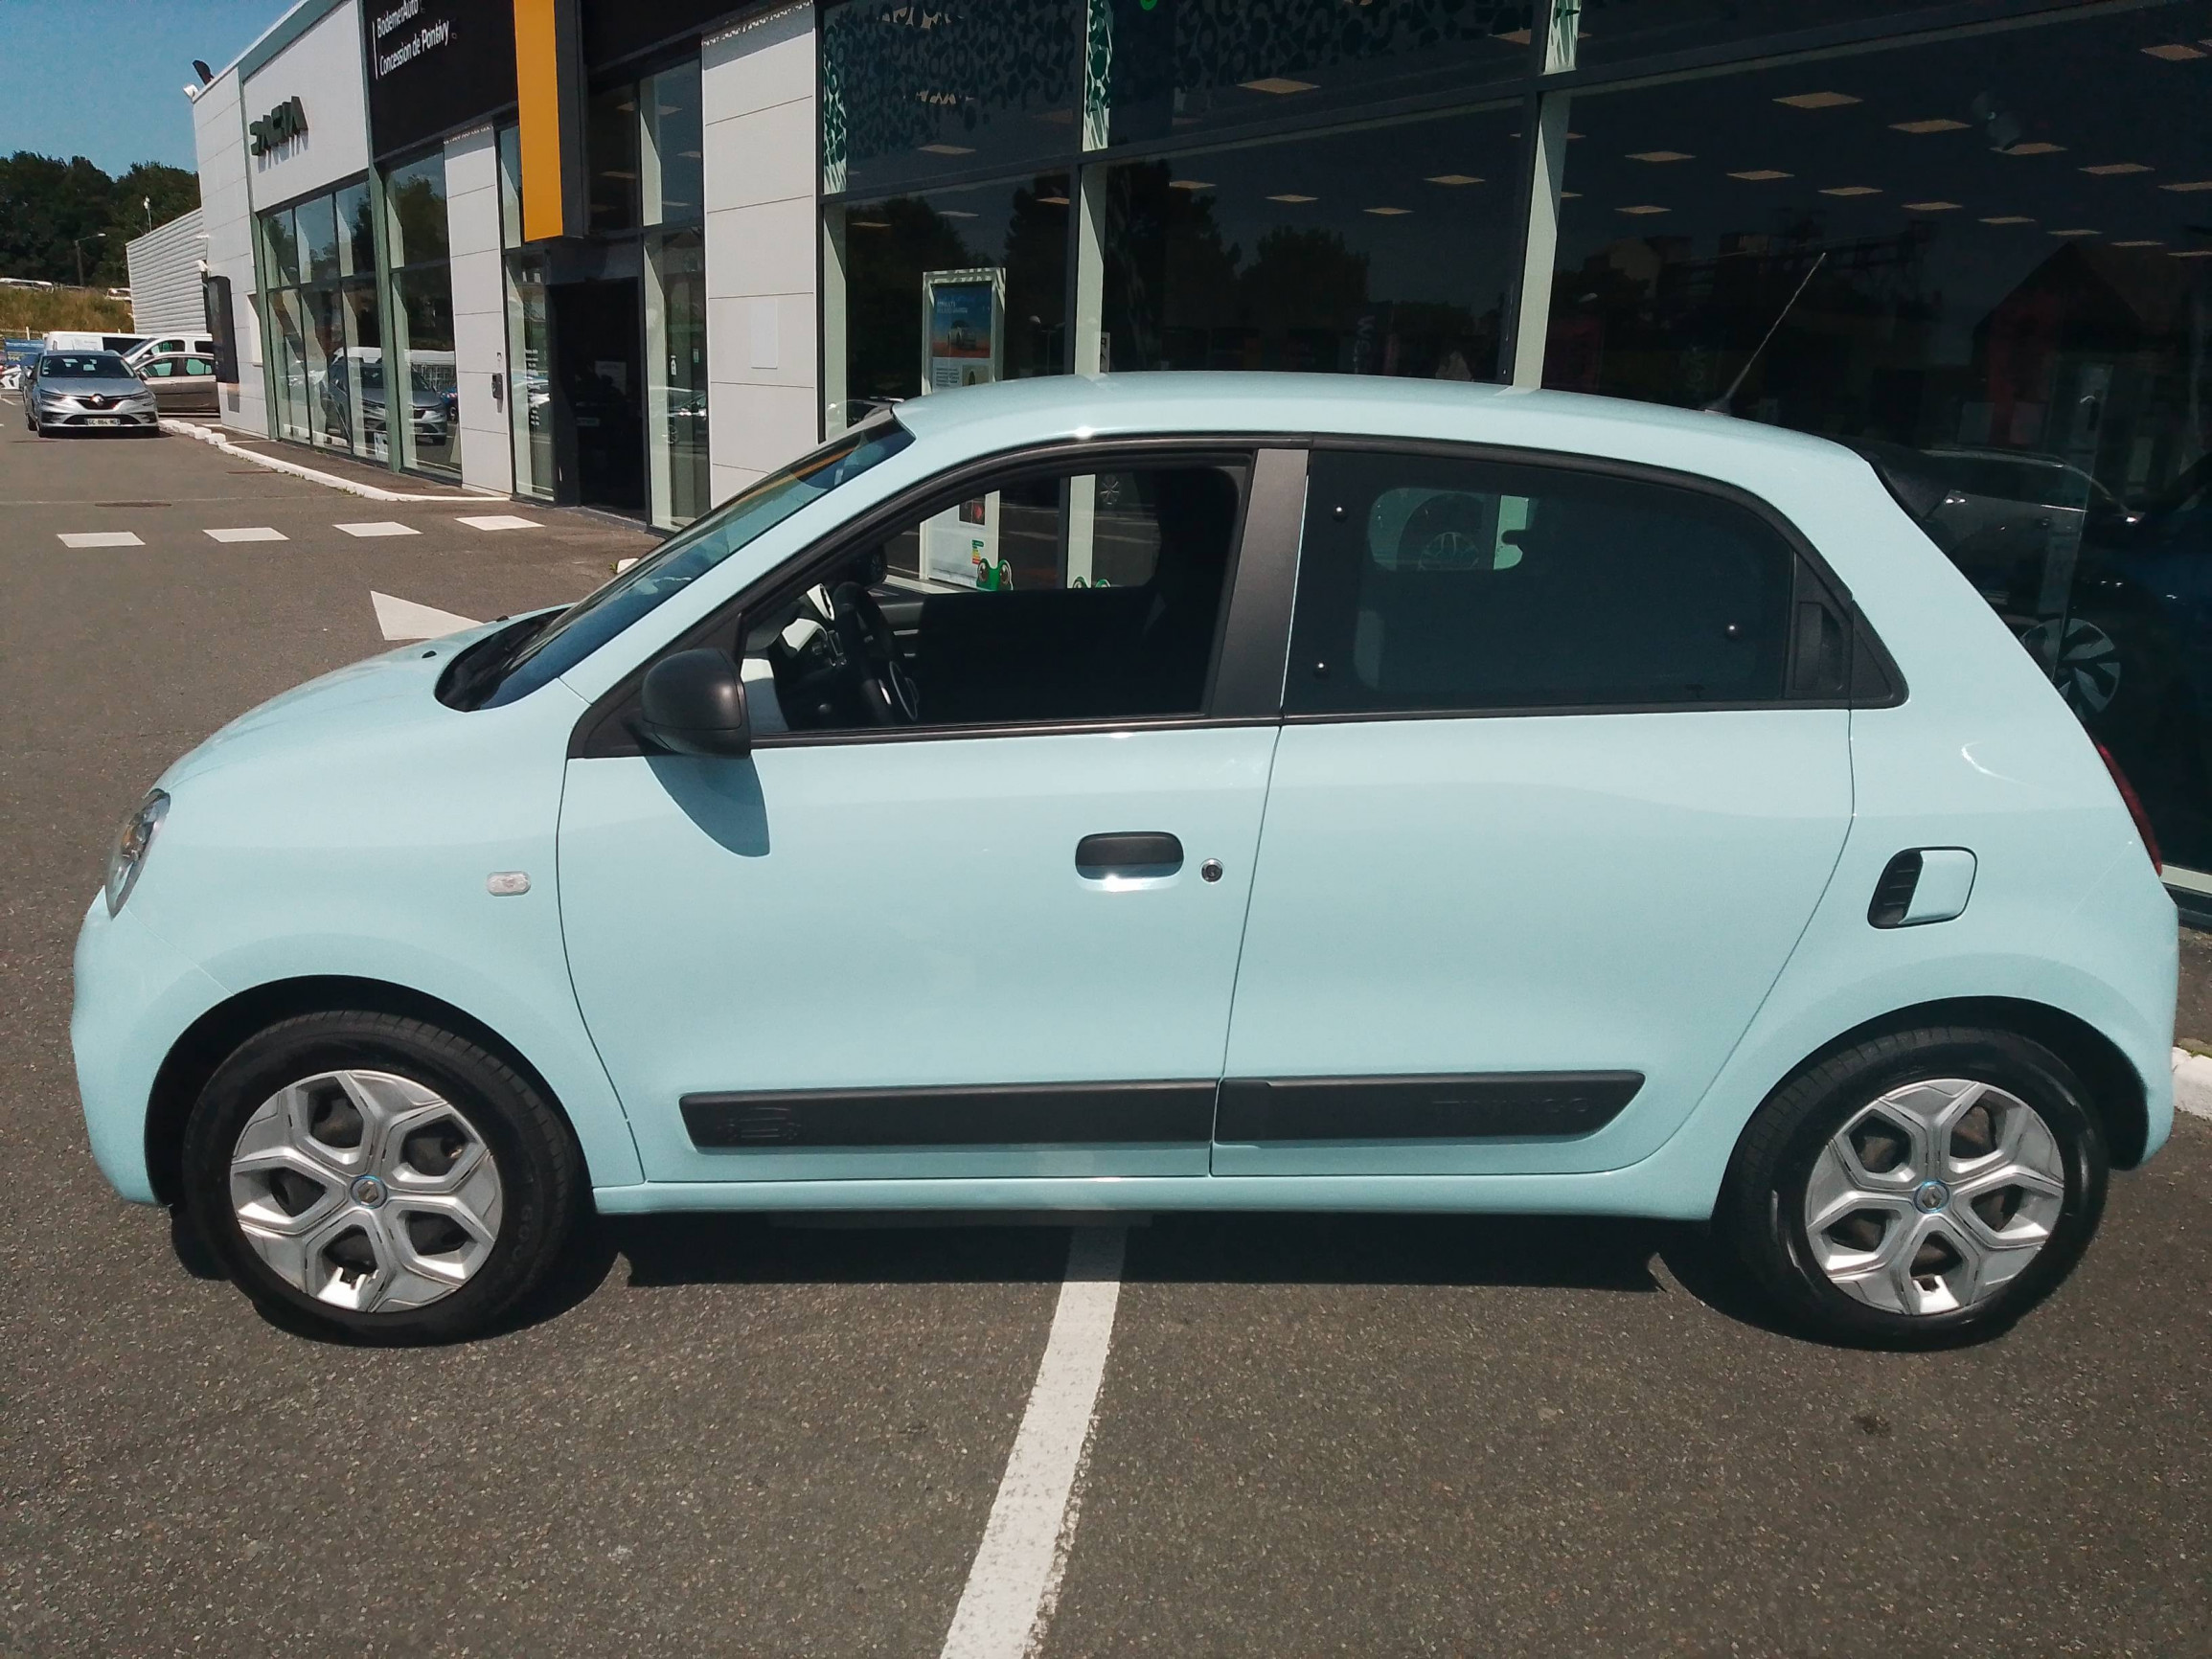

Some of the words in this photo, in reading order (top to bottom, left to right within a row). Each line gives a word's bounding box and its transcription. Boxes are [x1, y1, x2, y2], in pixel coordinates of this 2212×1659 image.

[376, 0, 420, 38] BodemerAuto
[379, 41, 412, 76] Concession
[412, 34, 421, 57] de
[422, 19, 449, 53] Pontivy
